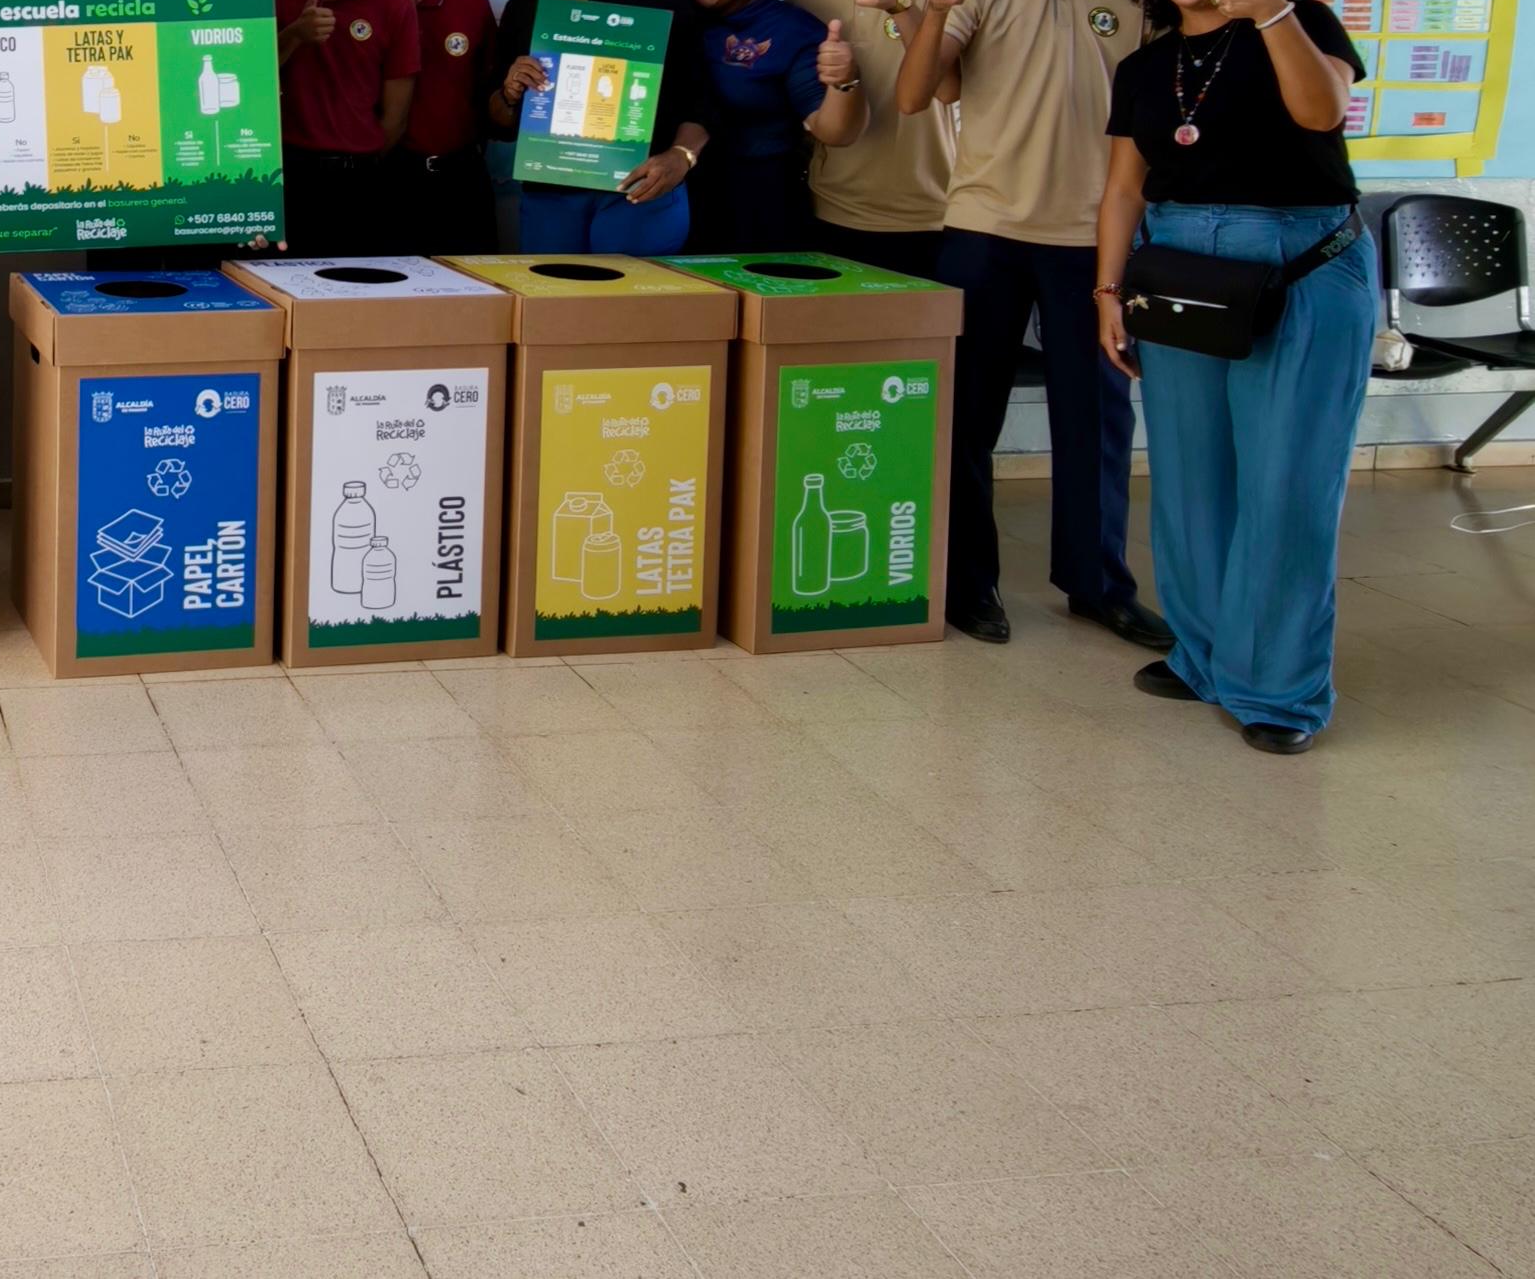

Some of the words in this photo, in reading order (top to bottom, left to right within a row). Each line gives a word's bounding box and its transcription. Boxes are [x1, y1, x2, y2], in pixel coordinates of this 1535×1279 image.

[0, 0, 80, 20] escuela
[74, 31, 114, 47] LATAS
[116, 29, 124, 45] Y
[191, 27, 244, 46] VIDRIOS
[553, 33, 590, 44] Estación
[591, 37, 603, 46] de
[66, 46, 106, 63] TETRA
[111, 45, 133, 62] PAK
[128, 133, 141, 142] No
[239, 128, 254, 136] No
[15, 138, 28, 146] No
[83, 201, 96, 209] en
[97, 199, 106, 208] el
[108, 199, 150, 208] basurero
[187, 214, 214, 224] +507
[217, 212, 245, 223] 6840
[247, 210, 275, 222] 3556
[174, 223, 276, 237] basuracero@pty.gob.pa
[115, 400, 154, 409] ALCALDÍA
[223, 396, 250, 410] CERO
[350, 394, 386, 402] ALCALDÍA
[454, 390, 479, 404] CERO
[144, 433, 196, 449] Reciclaje
[376, 427, 426, 442] Reciclaje
[667, 477, 697, 524] PAK
[432, 496, 466, 600] PLÁSTICO
[888, 500, 917, 586] VIDRIOS
[212, 520, 246, 608] CARTÓN
[635, 526, 665, 597] LATAS
[666, 528, 695, 594] TETRA
[183, 538, 213, 610] PAPEL
